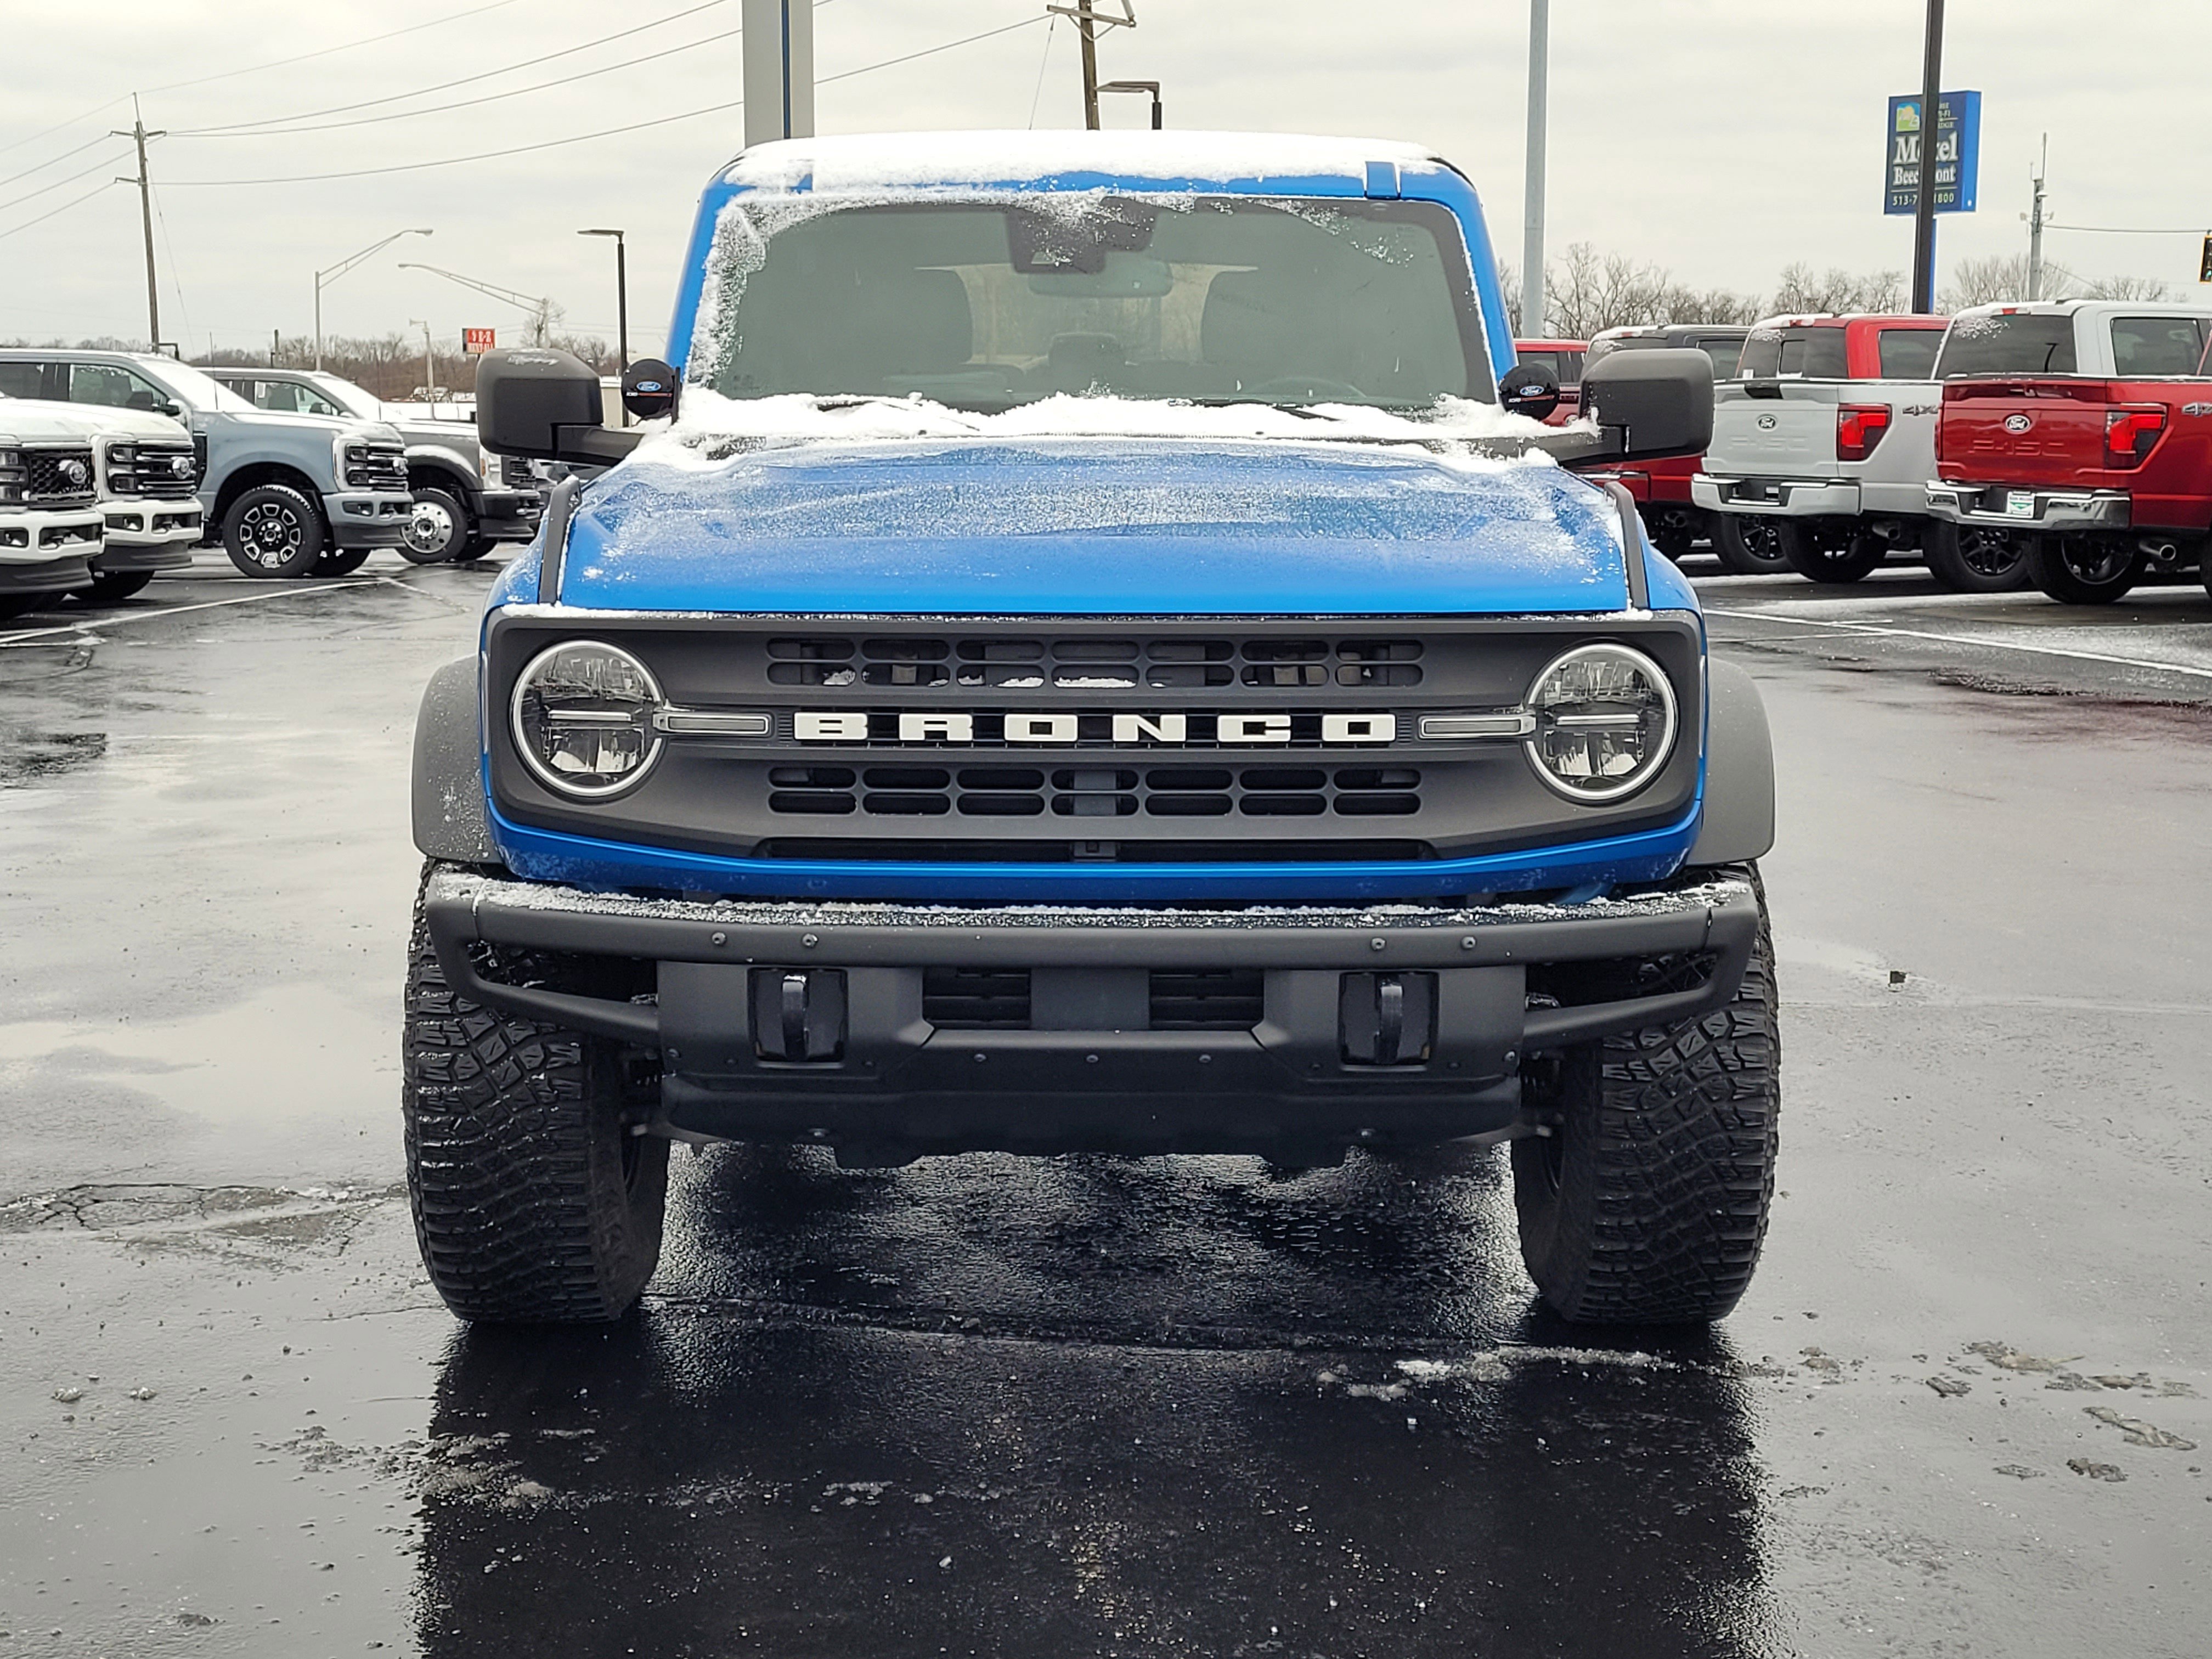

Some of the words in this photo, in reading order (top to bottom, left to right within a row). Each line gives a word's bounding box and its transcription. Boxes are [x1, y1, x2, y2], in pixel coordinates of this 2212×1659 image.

[1893, 132, 1959, 165] Mel
[1893, 165, 1957, 186] Beecont
[794, 713, 1396, 742] BRONCO
